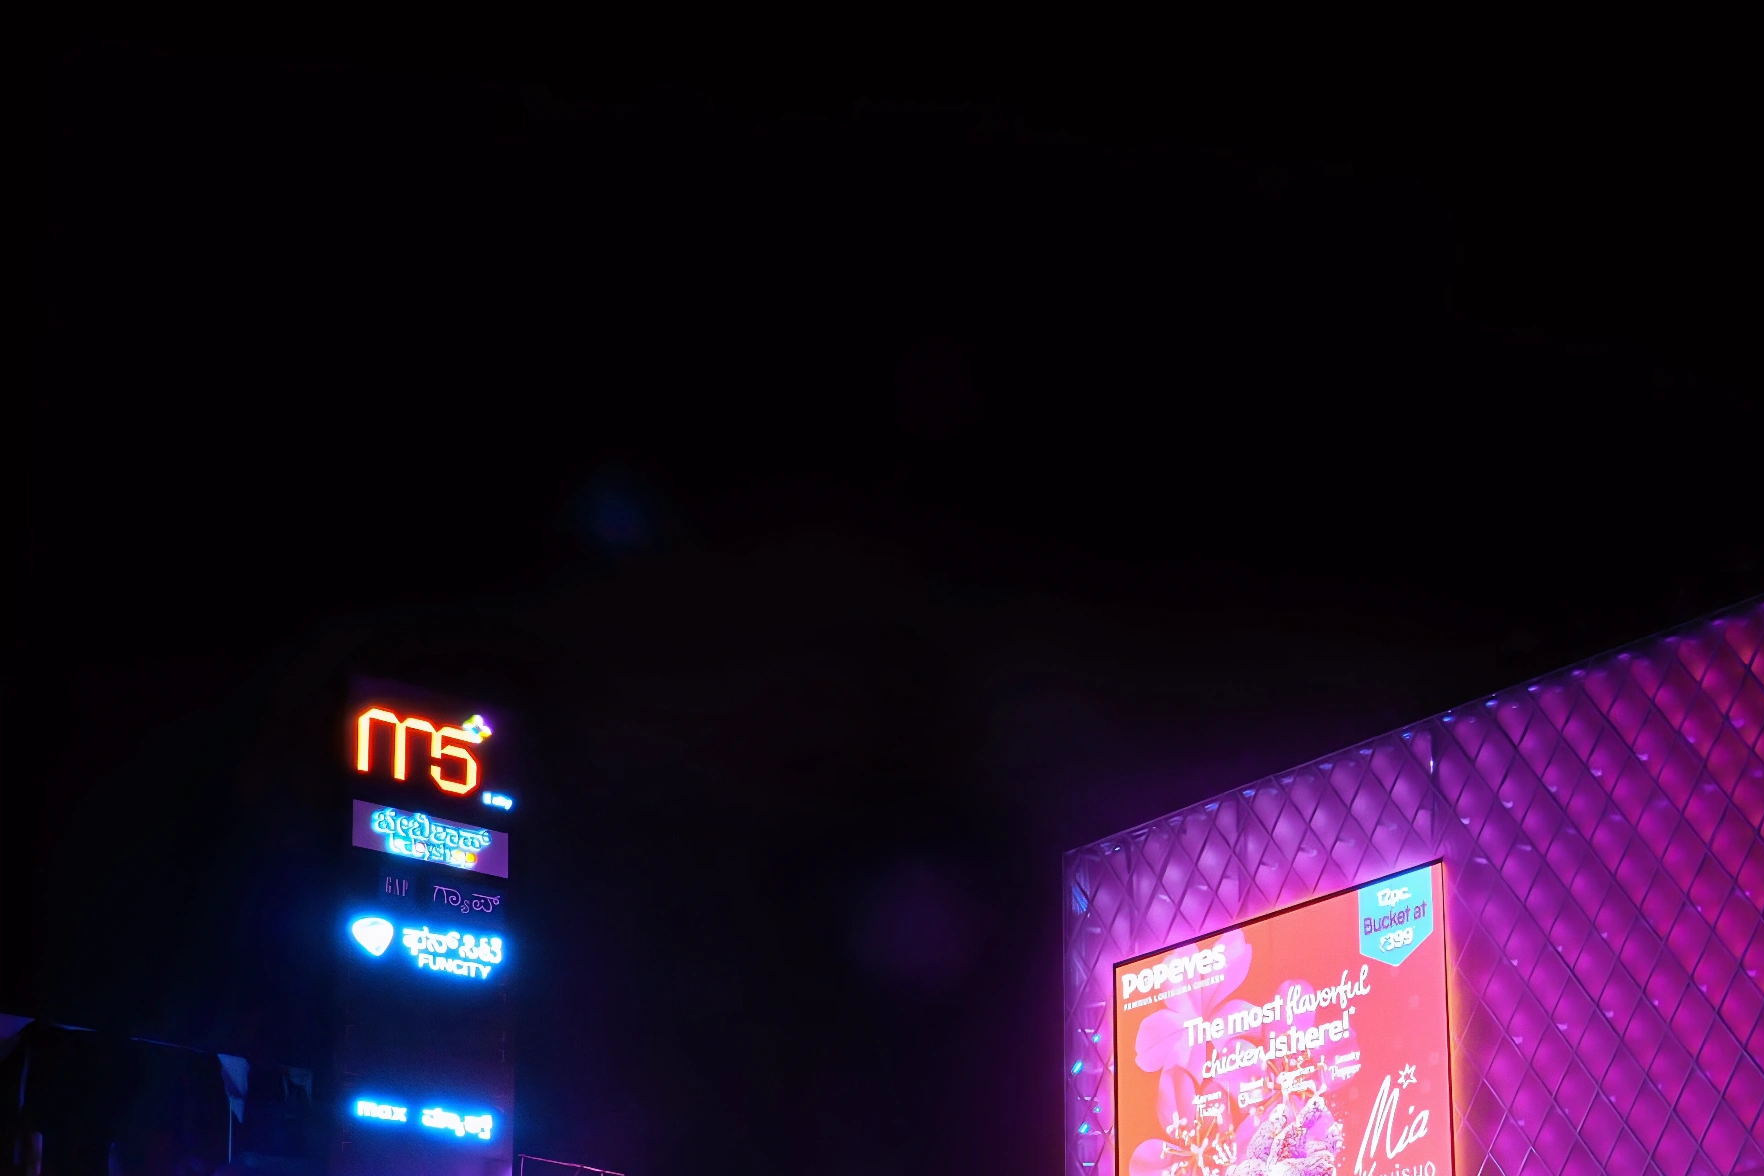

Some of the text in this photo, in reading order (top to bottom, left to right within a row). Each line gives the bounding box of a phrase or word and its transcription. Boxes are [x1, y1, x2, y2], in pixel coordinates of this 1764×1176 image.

[386, 877, 408, 896] GAP
[1364, 900, 1427, 935] Bucket at
[418, 953, 492, 980] FUNCITY
[1183, 964, 1371, 1047] The most flavorful
[1202, 1042, 1271, 1079] chicken
[1269, 1031, 1289, 1059] is
[357, 1100, 407, 1122] max
[1354, 1074, 1429, 1175] Mia
